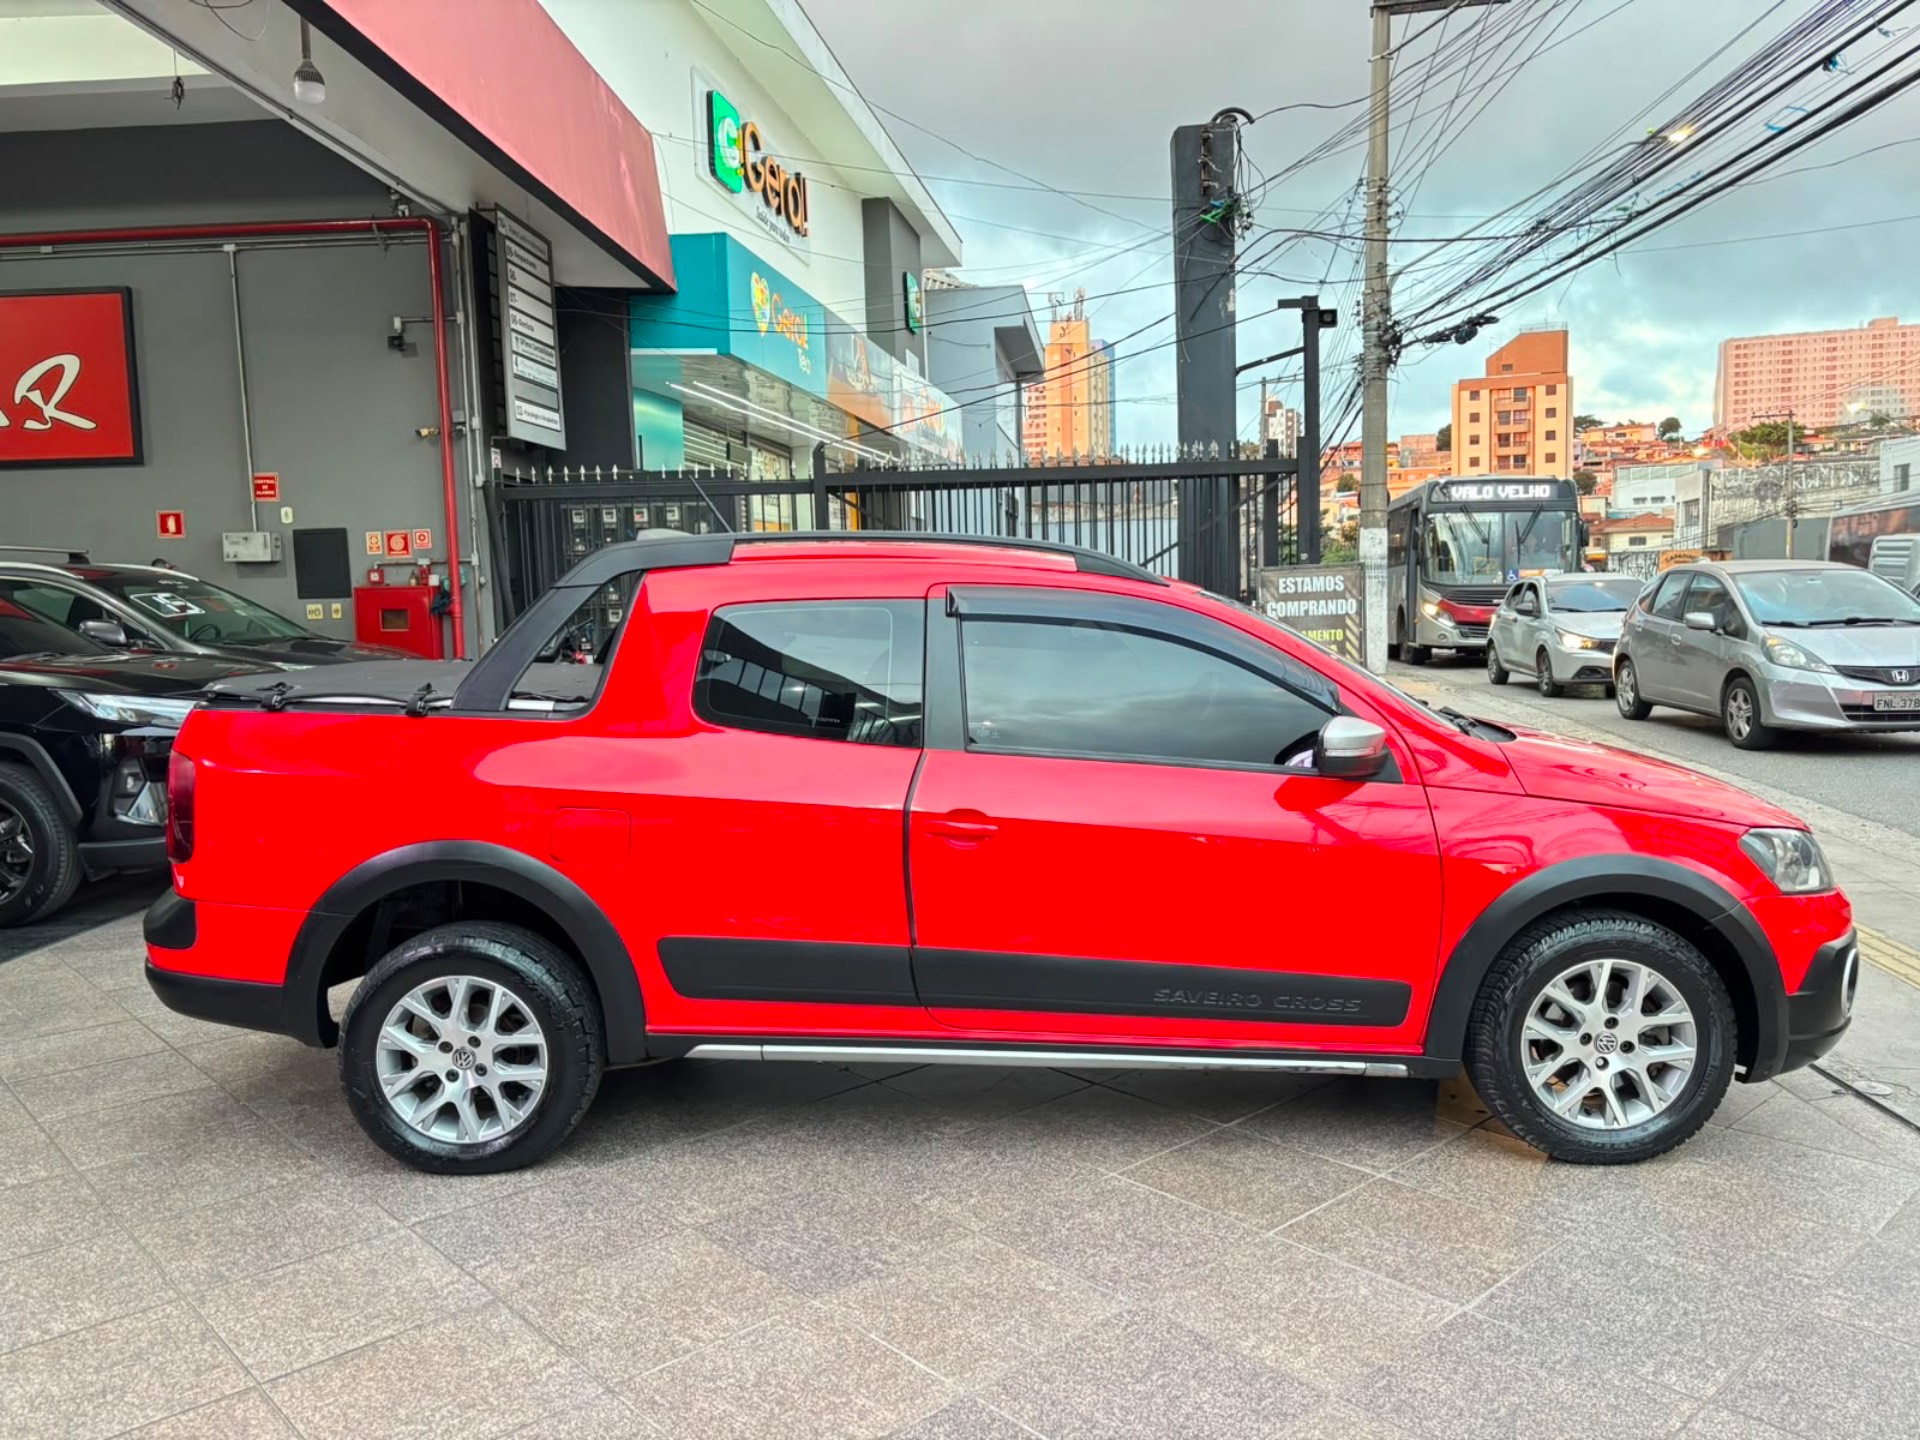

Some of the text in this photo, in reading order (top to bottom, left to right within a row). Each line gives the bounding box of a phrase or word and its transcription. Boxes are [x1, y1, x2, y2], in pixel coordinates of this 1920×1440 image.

[1497, 485, 1550, 498] VELHO
[1278, 575, 1345, 594] ESTAMOS
[1266, 598, 1357, 618] COMPRANDO
[1153, 988, 1362, 1012] SAVEIRO CROSS
